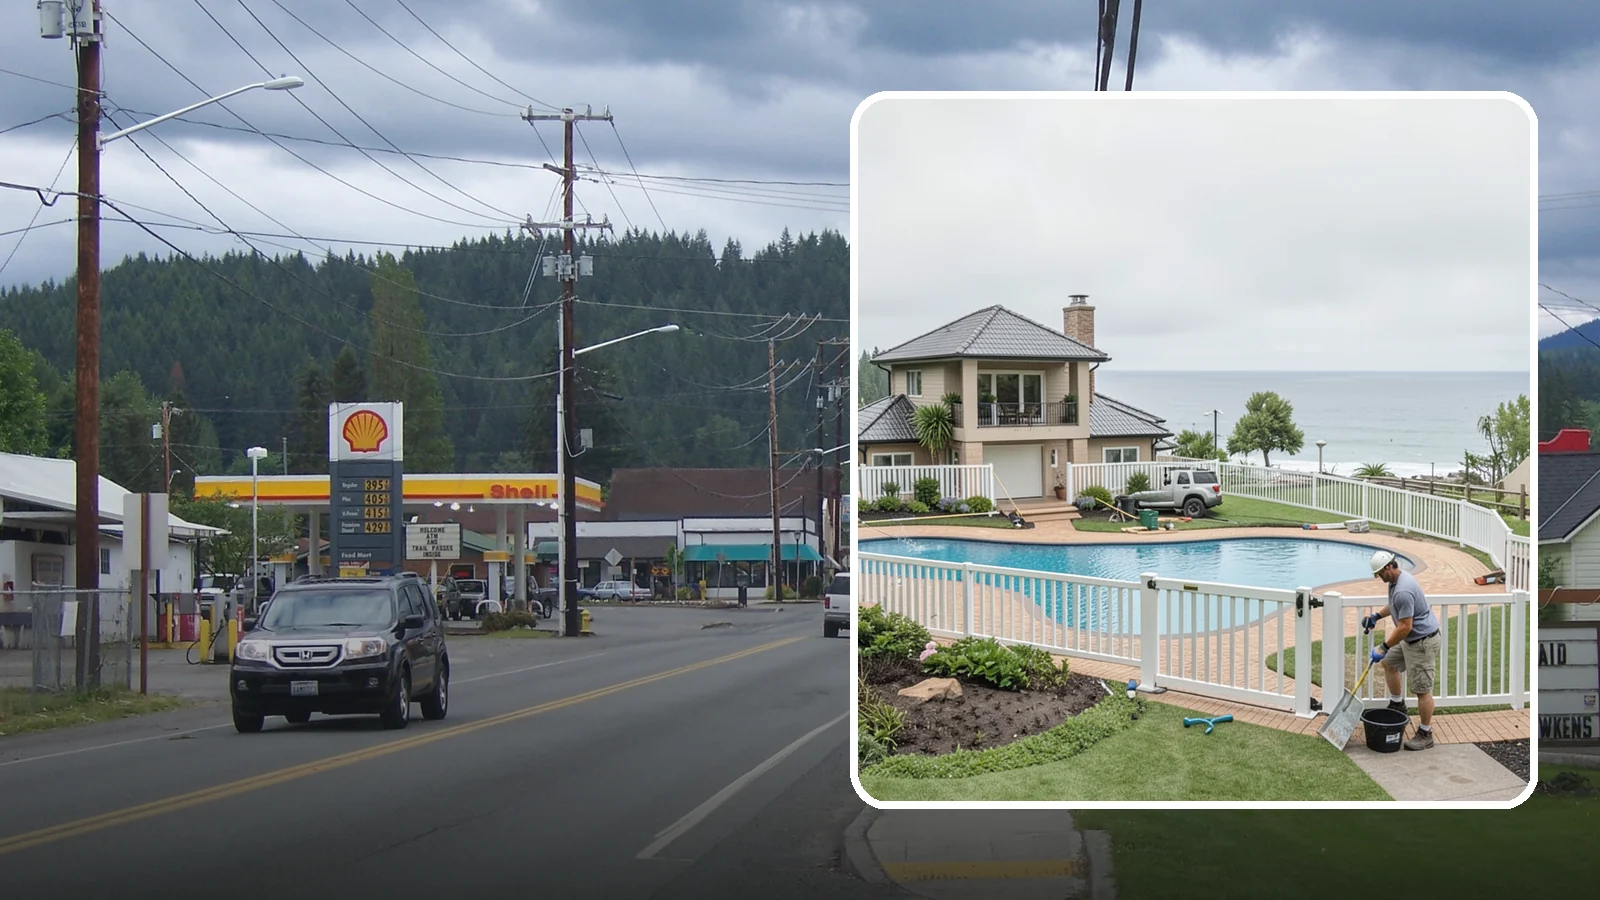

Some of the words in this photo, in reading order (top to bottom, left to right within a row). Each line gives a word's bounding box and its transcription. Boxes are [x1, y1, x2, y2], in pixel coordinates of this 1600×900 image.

[366, 480, 384, 490] 395
[490, 484, 547, 498] Shell
[366, 494, 384, 504] 405
[366, 508, 383, 518] 415
[366, 522, 384, 532] 429
